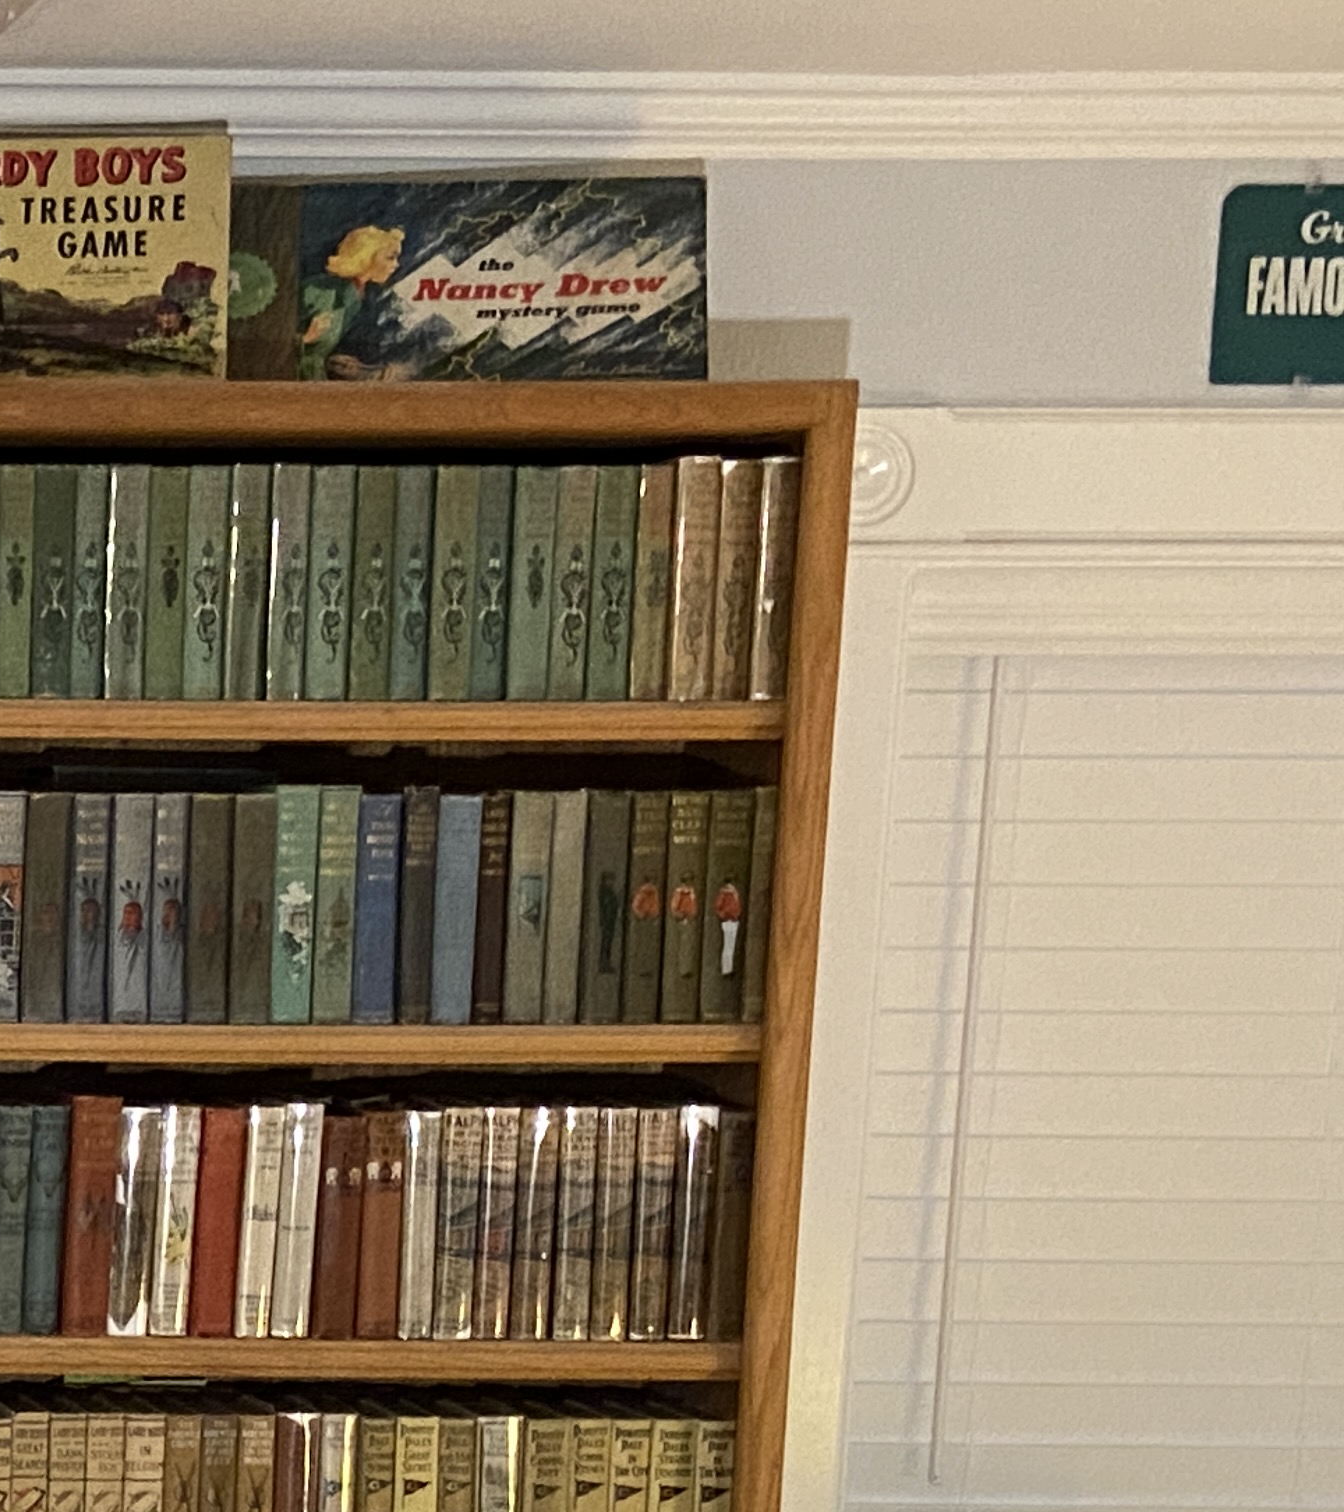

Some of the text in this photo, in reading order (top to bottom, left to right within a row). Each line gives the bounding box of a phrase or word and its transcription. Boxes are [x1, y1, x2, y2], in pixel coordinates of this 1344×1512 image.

[74, 145, 188, 188] BOYS
[20, 194, 187, 225] TREASURE
[57, 229, 149, 259] GAME
[478, 258, 515, 273] the
[412, 272, 670, 304] Nancy Drew
[475, 301, 641, 321] mystery game
